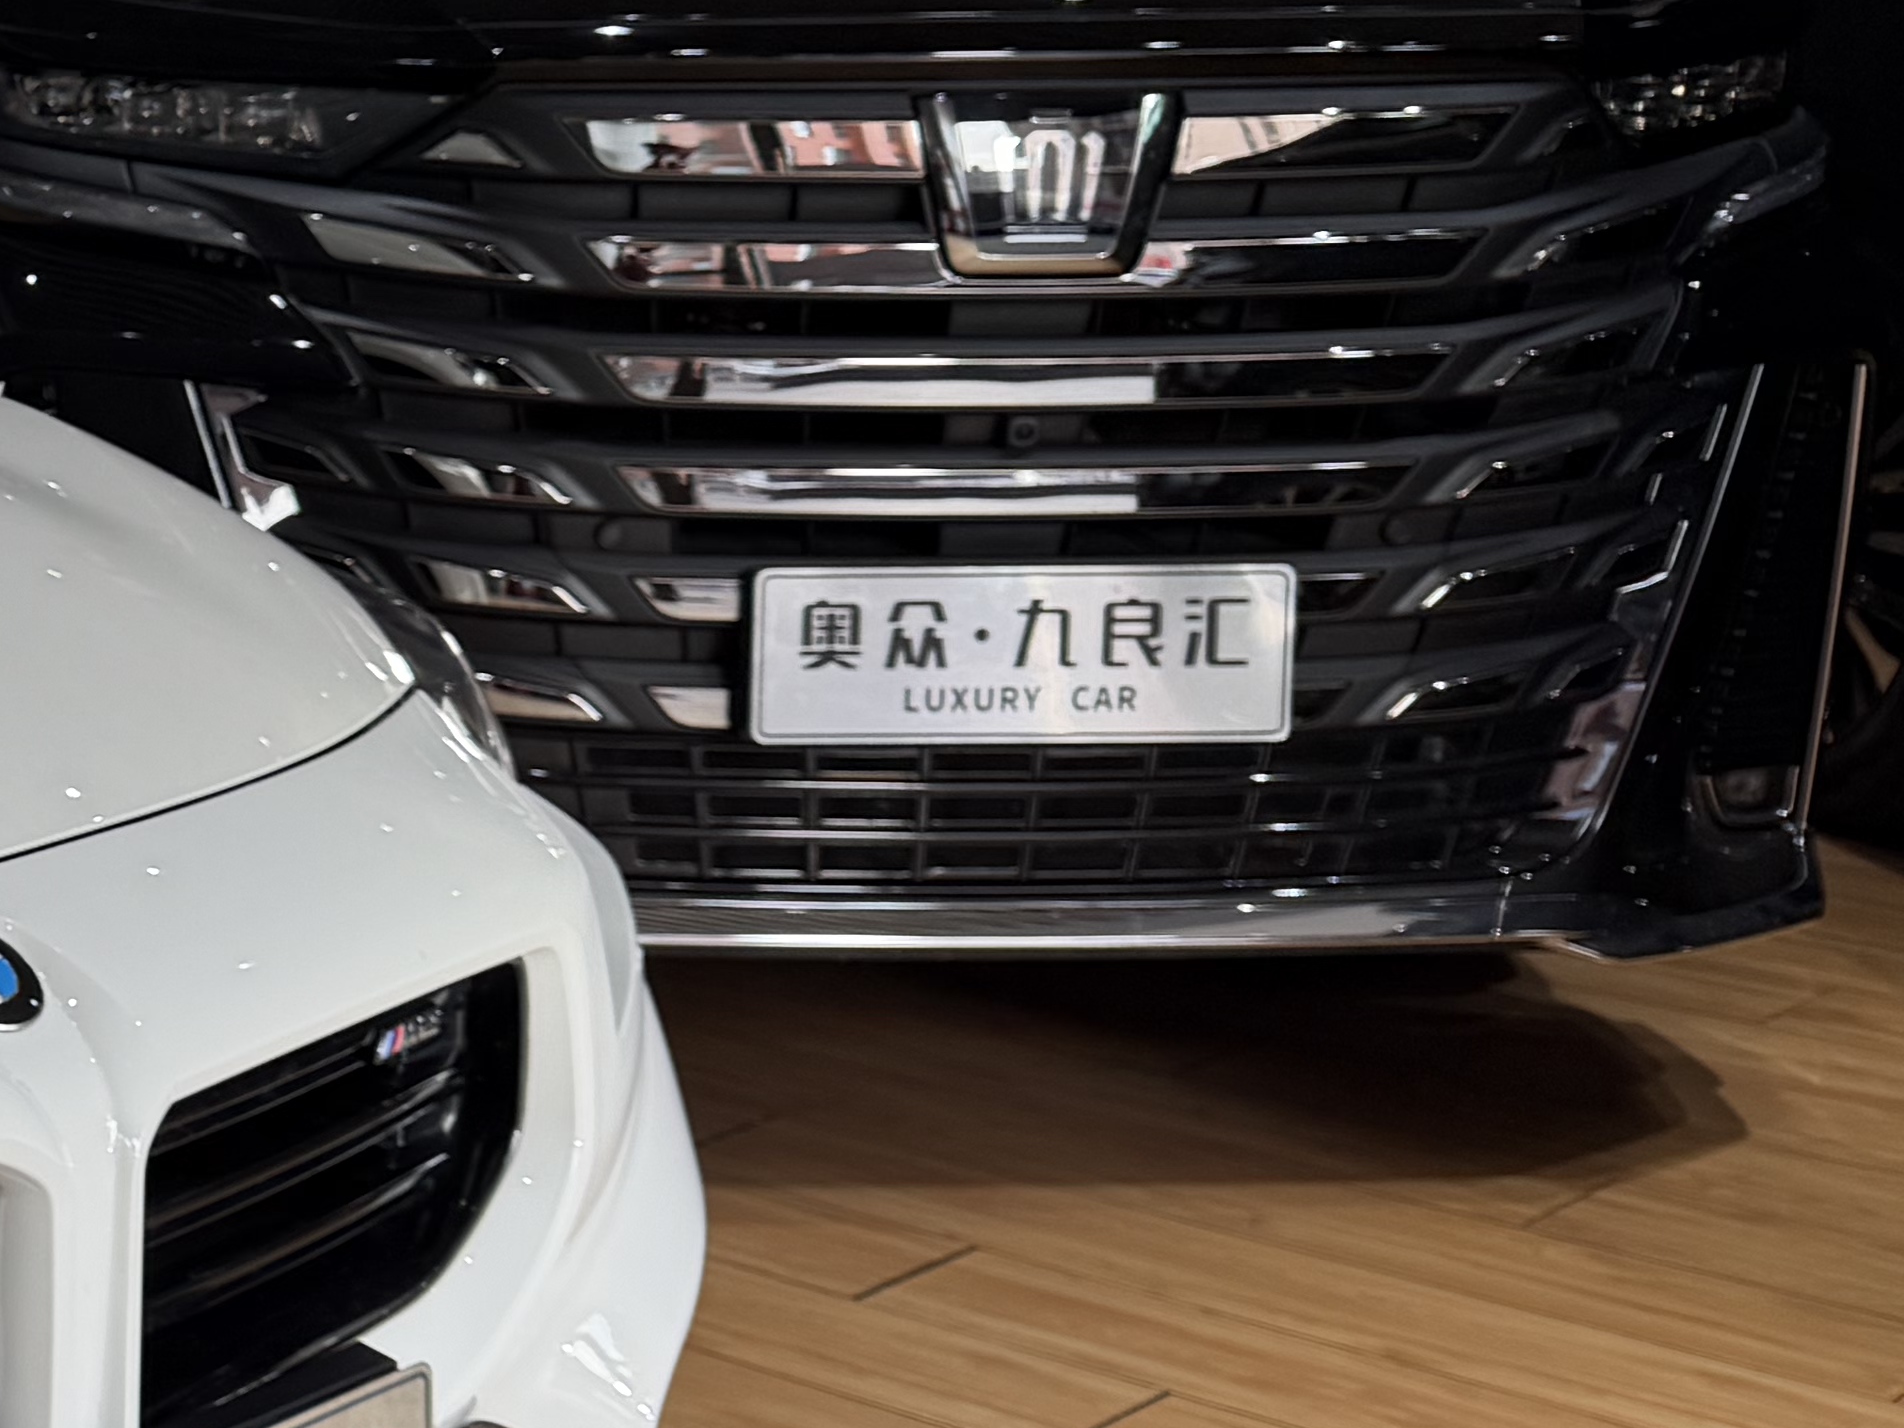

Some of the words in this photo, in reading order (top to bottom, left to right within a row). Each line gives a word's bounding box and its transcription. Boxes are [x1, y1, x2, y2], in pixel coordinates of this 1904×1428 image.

[799, 597, 1252, 670] 奥众·九良汇
[904, 686, 1044, 714] LUXURY
[1071, 685, 1138, 714] CAR
